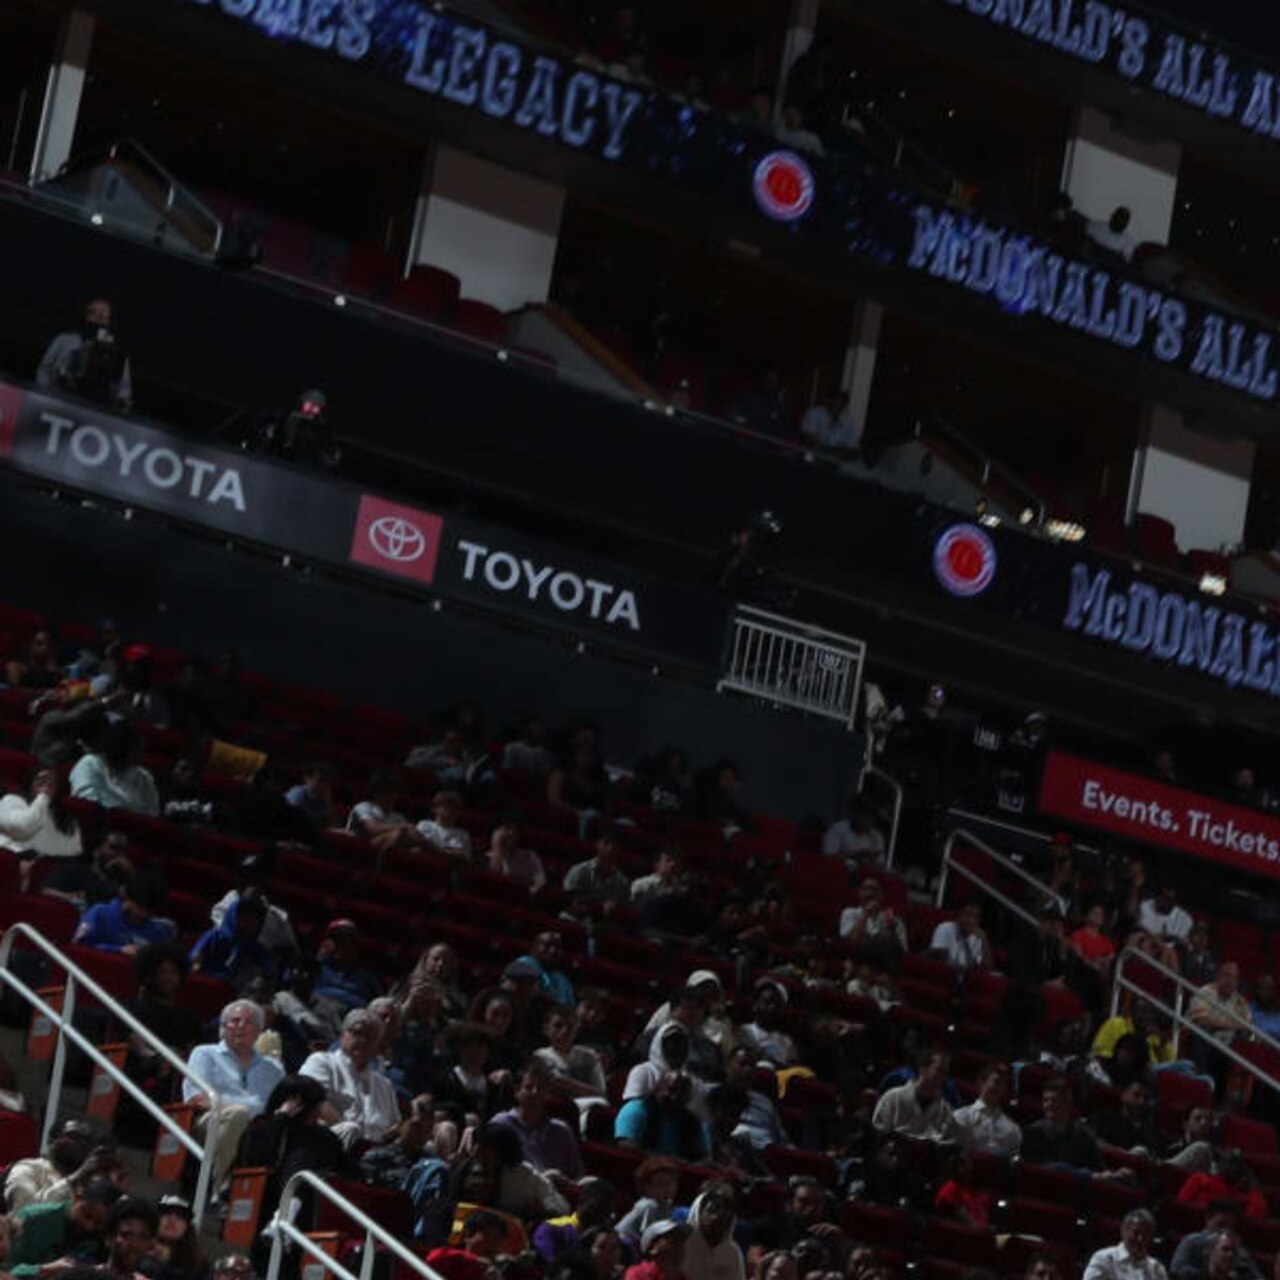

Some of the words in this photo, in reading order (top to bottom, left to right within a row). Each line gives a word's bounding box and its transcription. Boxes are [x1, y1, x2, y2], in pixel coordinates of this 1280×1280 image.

[403, 10, 643, 161] LEGACY
[1152, 33, 1239, 117] ALL
[906, 204, 1188, 363] McDONALD'S
[1190, 312, 1280, 400] ALL
[40, 411, 247, 512] TOYOTA
[457, 538, 642, 631] TOYOTA
[1081, 779, 1181, 834] Events.
